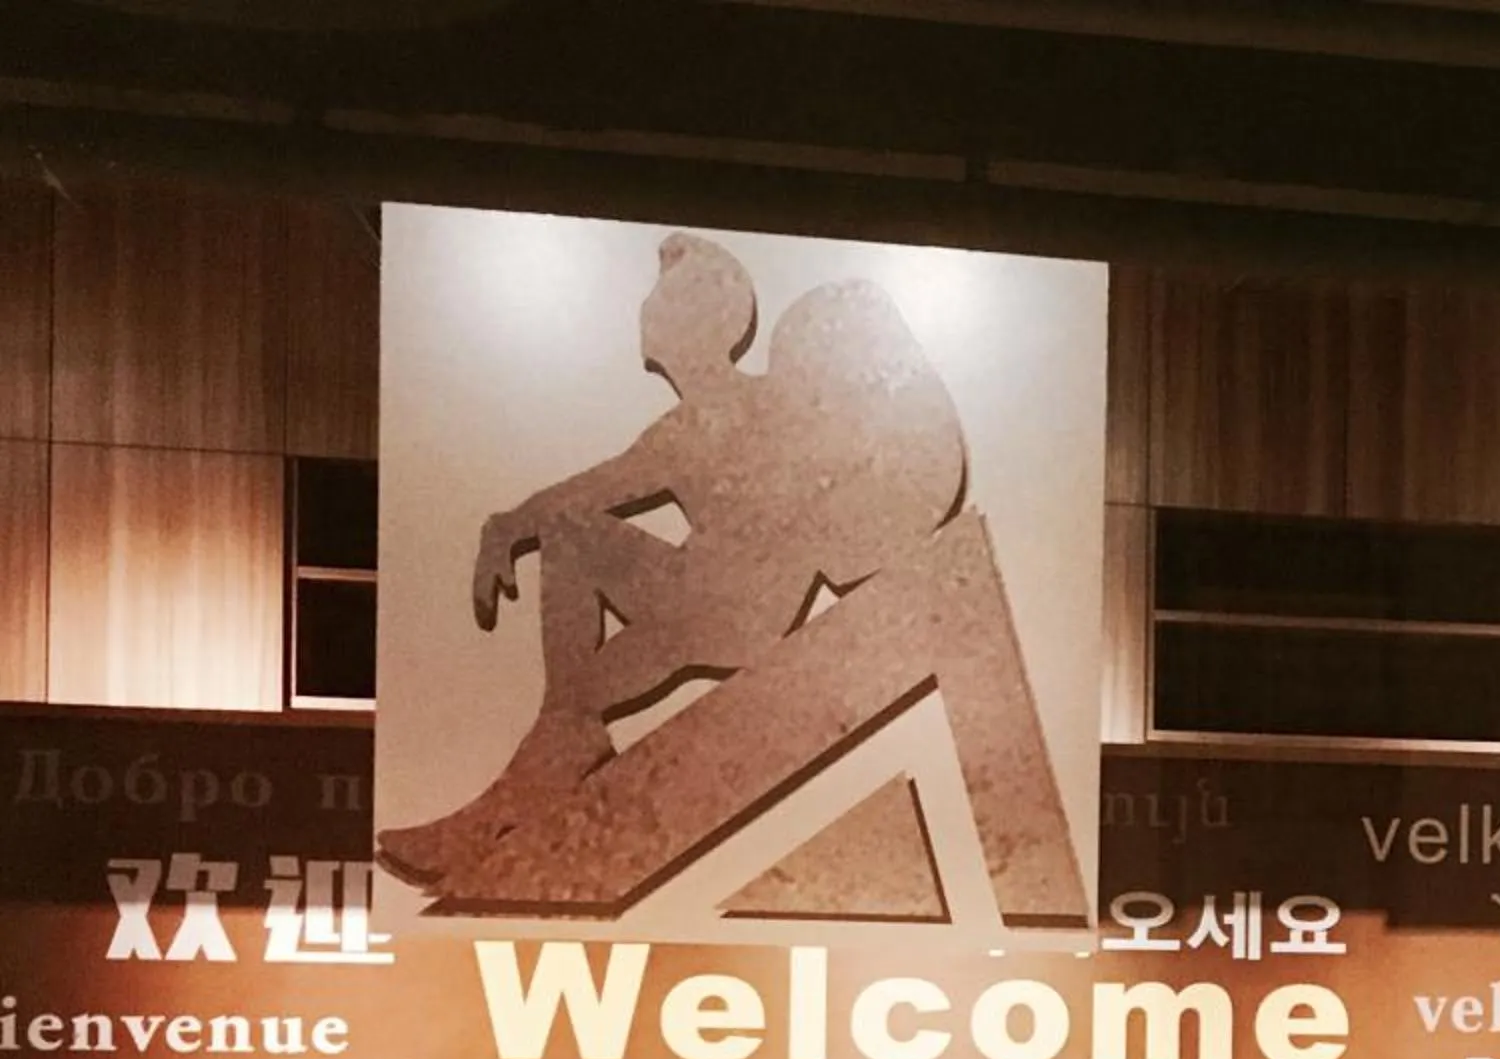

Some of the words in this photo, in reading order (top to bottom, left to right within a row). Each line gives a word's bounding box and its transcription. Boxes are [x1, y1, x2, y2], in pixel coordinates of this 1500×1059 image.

[15, 748, 273, 822] Добро
[106, 852, 395, 964] 欢迎
[1102, 891, 1347, 961] 오세요
[0, 996, 349, 1055] ienvenue
